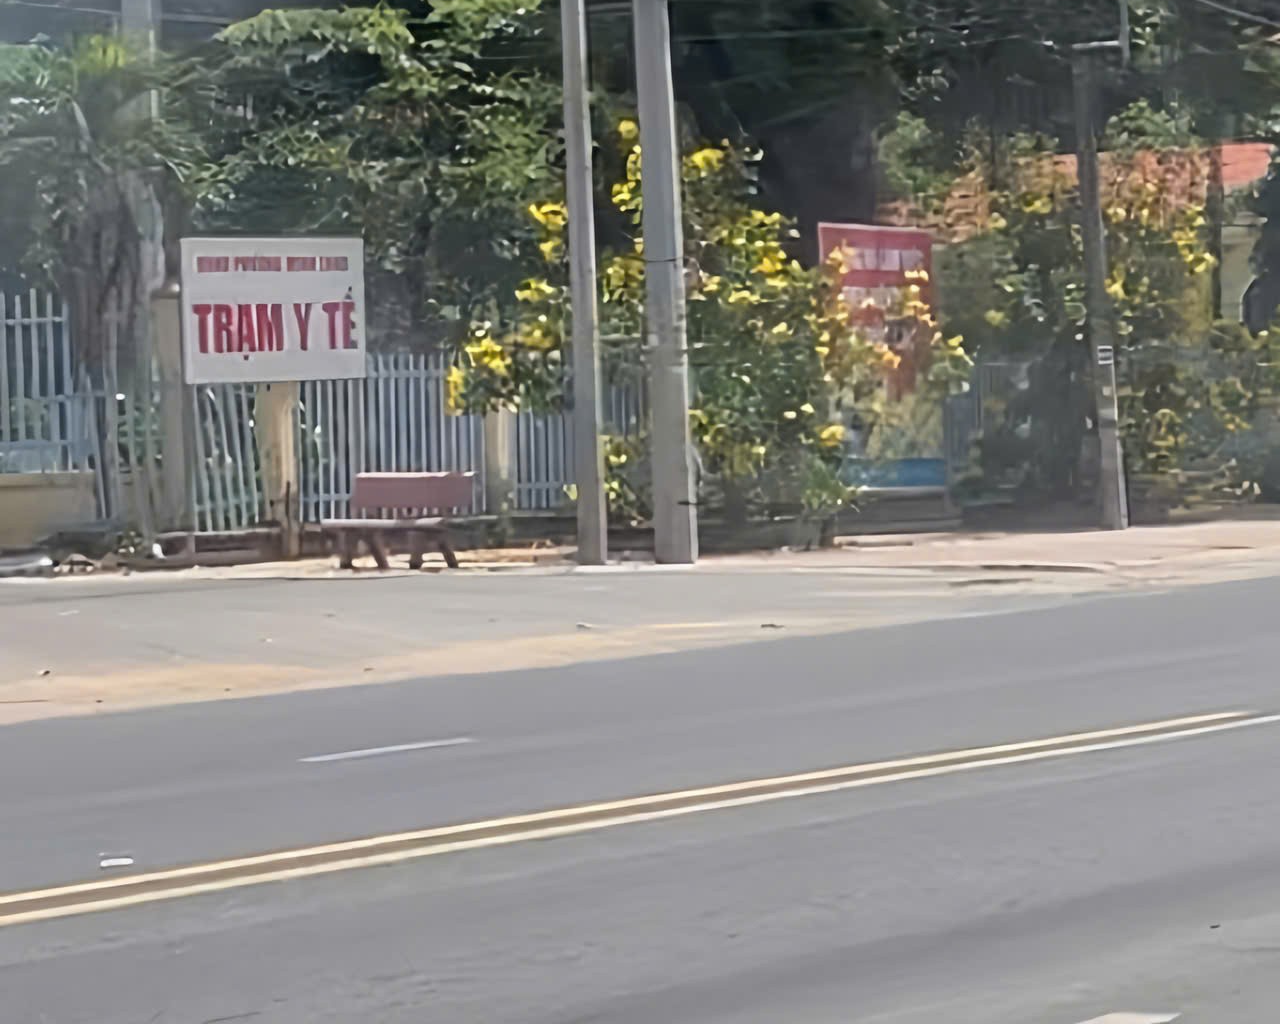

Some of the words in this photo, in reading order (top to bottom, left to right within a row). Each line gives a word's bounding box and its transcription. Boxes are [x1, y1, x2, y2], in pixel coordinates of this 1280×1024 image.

[192, 303, 285, 361] TRẠM
[293, 302, 312, 352] Y
[321, 285, 358, 350] TẾ
